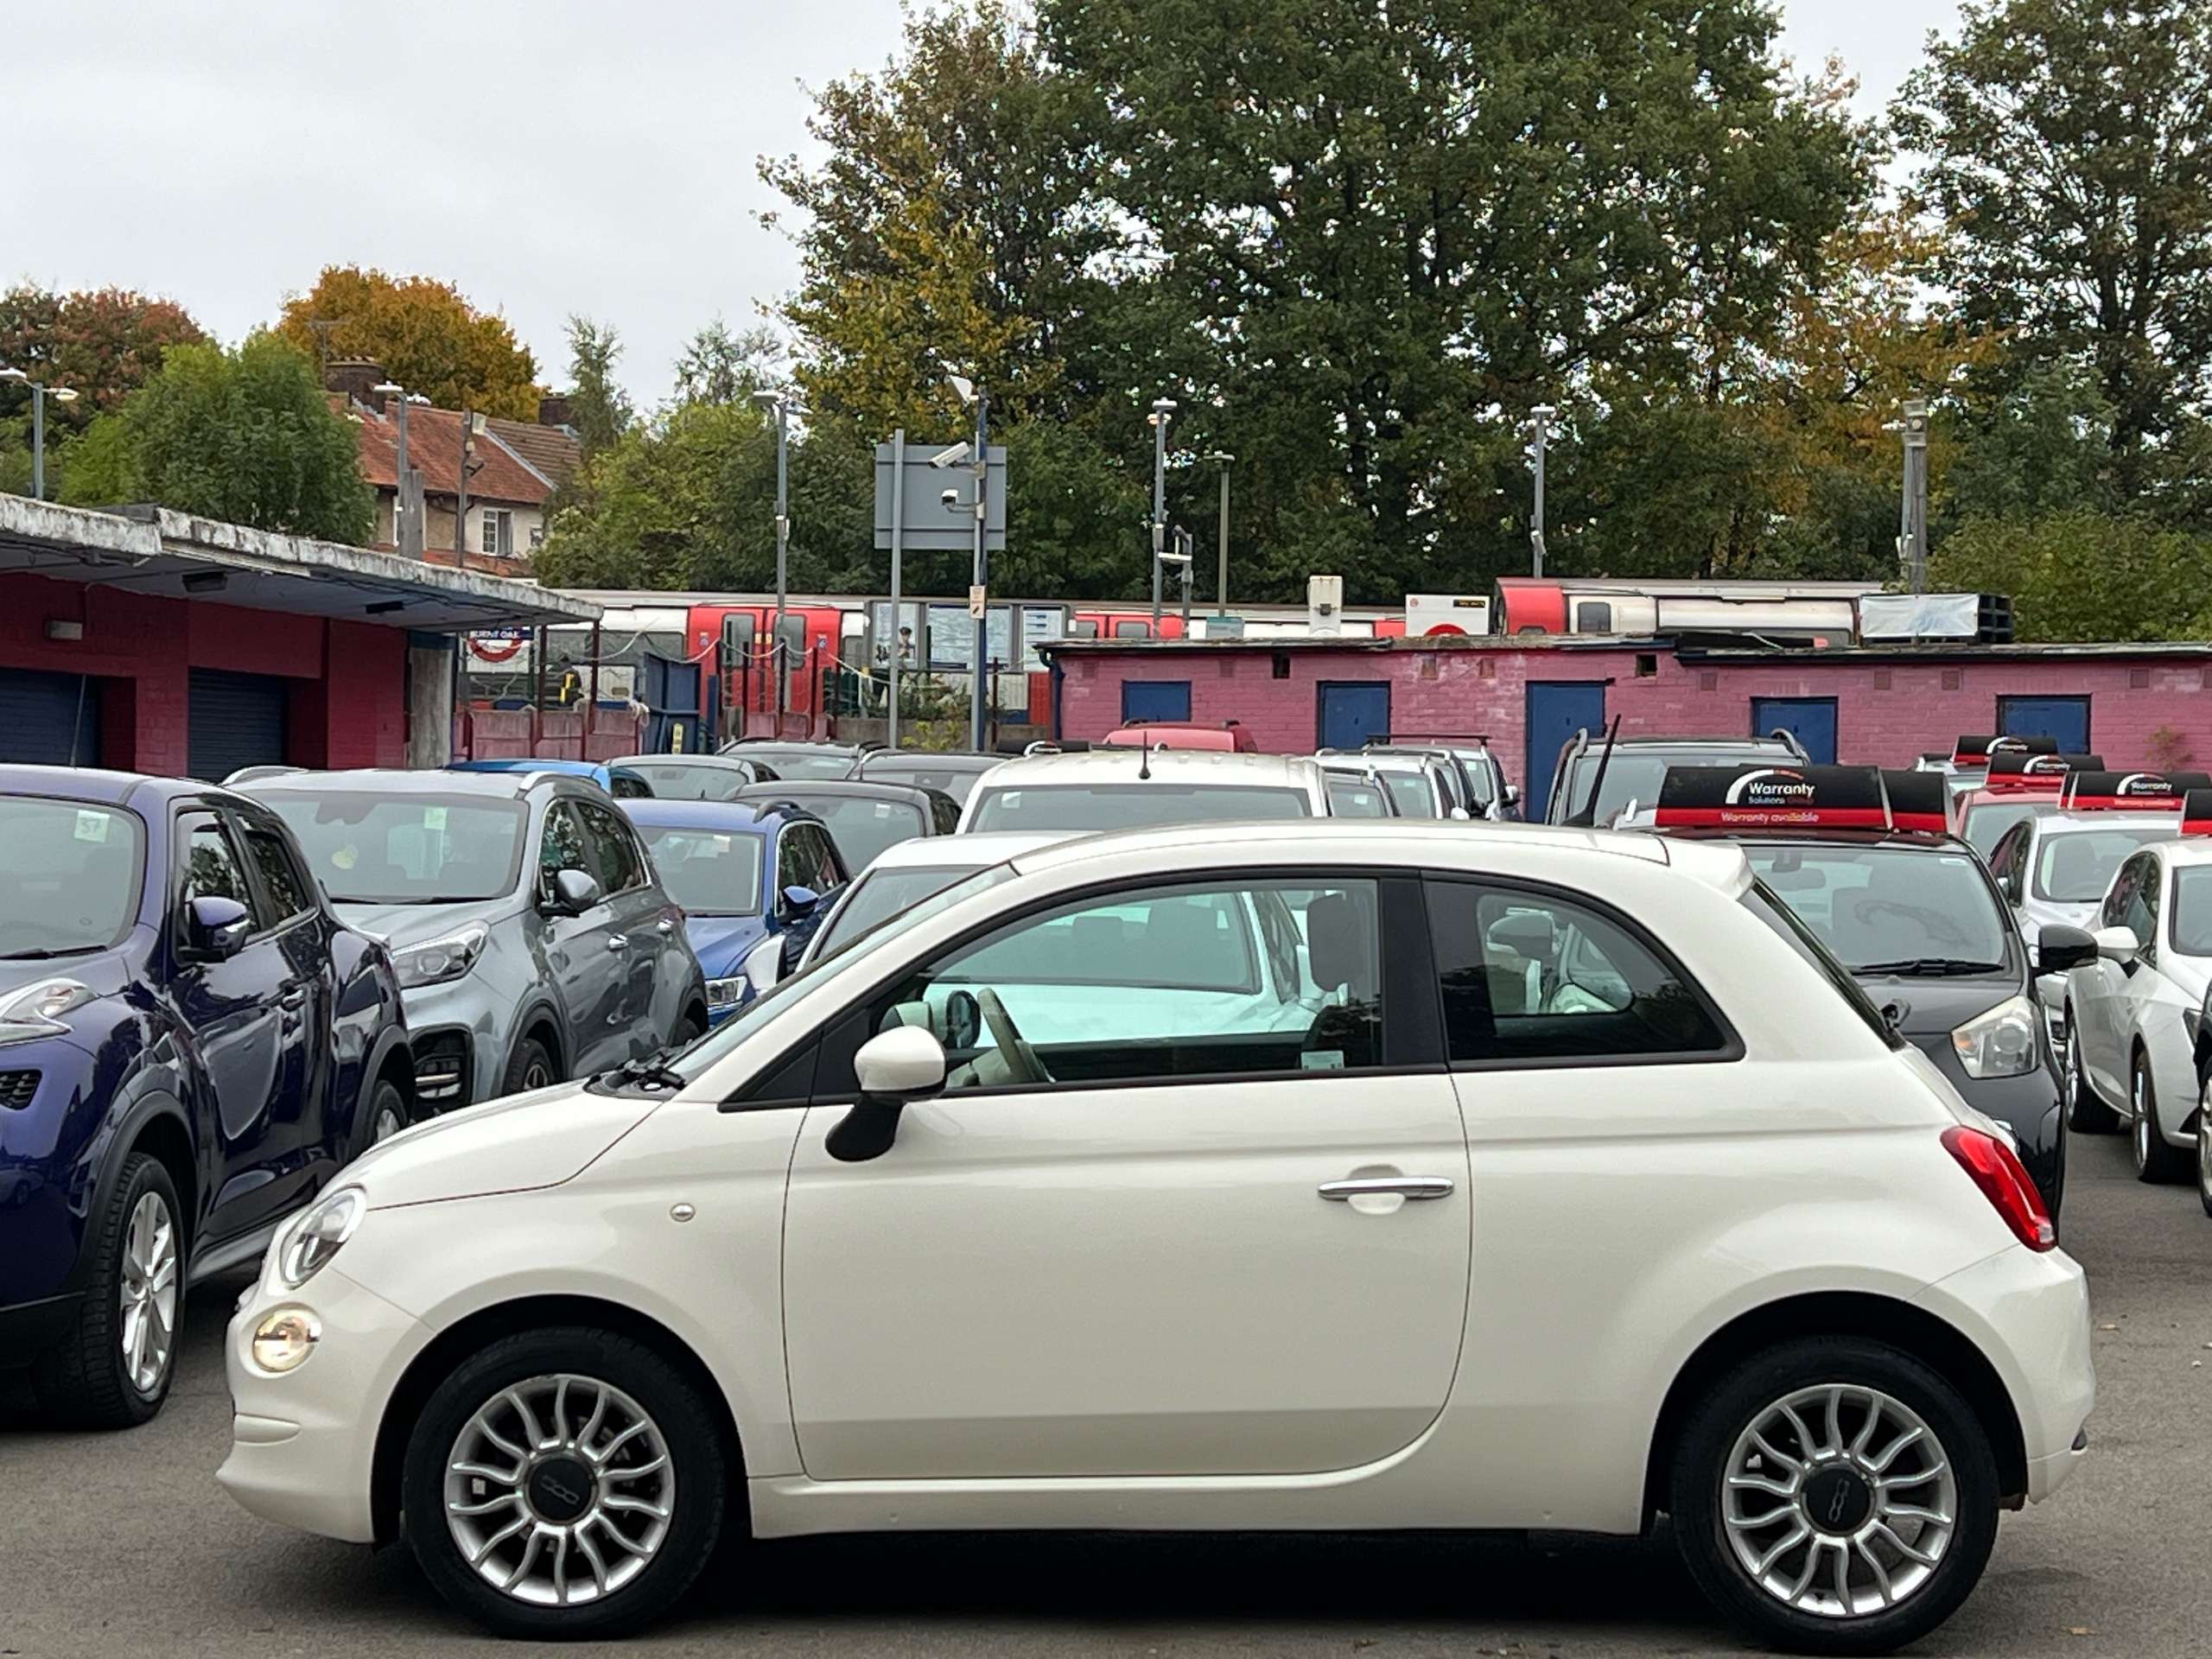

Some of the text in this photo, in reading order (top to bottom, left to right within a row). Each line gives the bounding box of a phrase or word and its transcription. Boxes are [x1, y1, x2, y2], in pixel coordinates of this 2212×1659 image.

[1749, 783, 1815, 798] Warranty
[2131, 781, 2172, 791] Warranty
[1721, 812, 1819, 824] Warranty available
